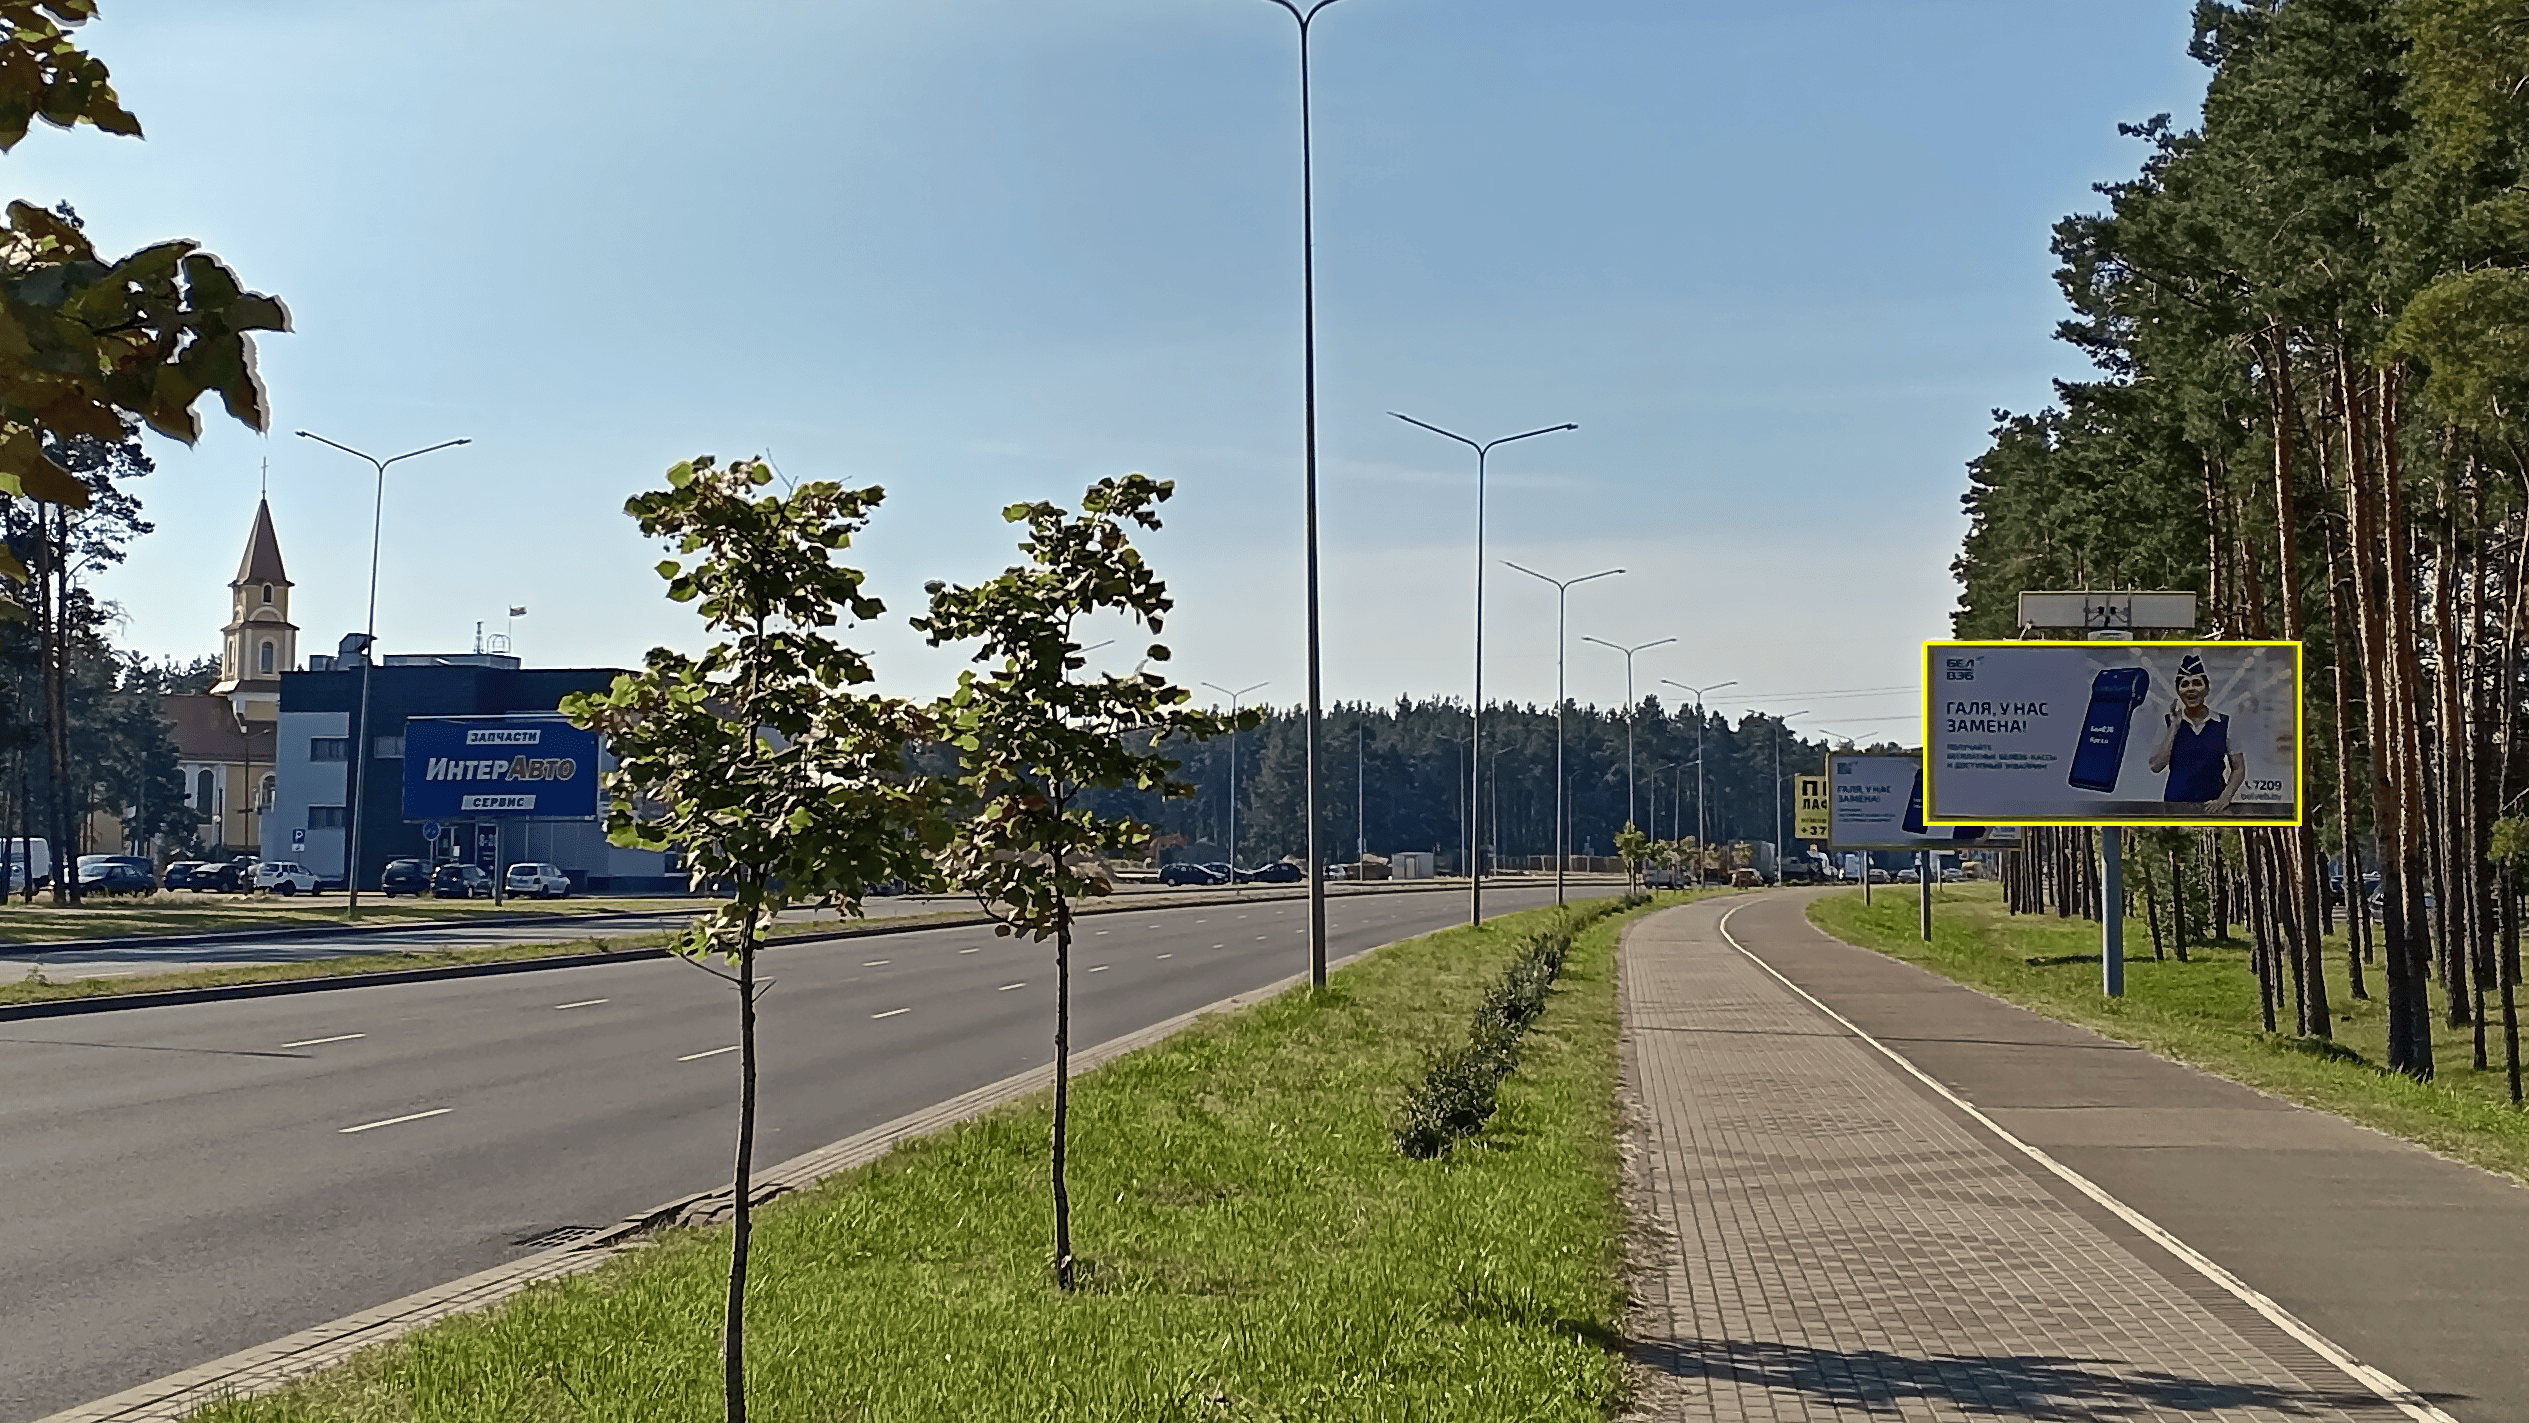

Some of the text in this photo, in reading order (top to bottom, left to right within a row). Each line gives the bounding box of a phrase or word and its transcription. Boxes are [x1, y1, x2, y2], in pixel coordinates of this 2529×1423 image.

[1946, 701, 2049, 717] ГАЛЯ, У НАС
[1946, 719, 2027, 734] ЗАМЕНА!
[471, 732, 538, 743] ЗАПЧАСТИ
[2252, 780, 2282, 791] 7209
[472, 797, 525, 808] СЕРВИС
